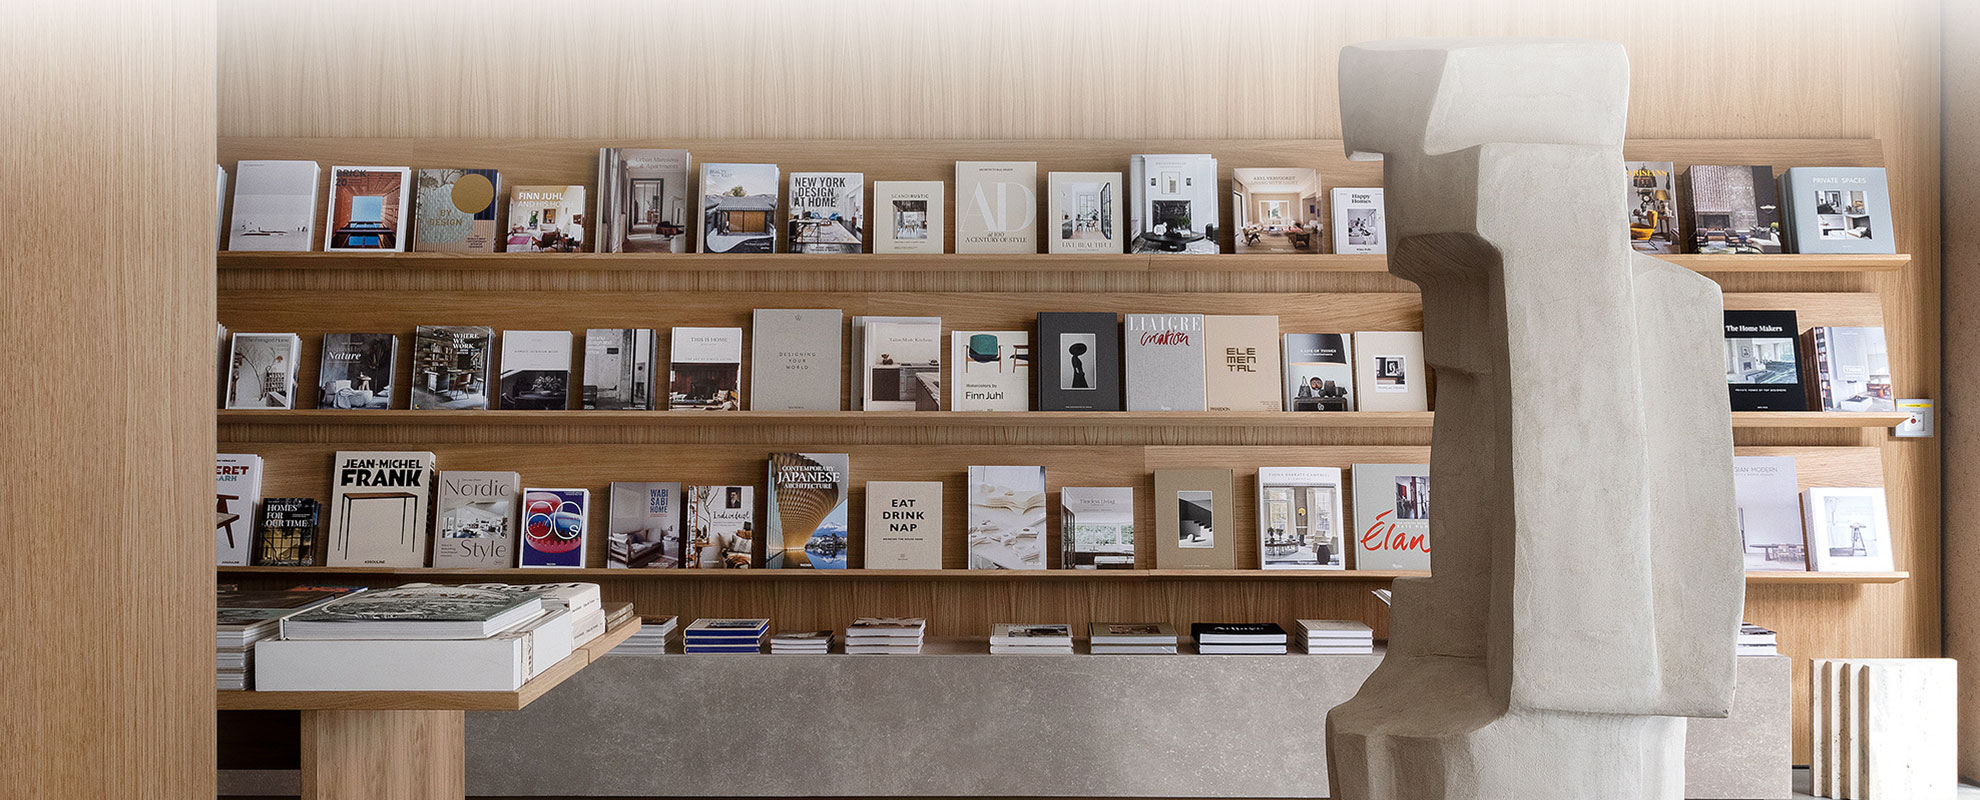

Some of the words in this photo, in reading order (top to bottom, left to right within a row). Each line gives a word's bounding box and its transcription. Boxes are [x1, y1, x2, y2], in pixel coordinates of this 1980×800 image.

[336, 169, 367, 178] BRICK
[335, 178, 348, 187] 20
[794, 177, 816, 188] NEW
[819, 177, 846, 188] YORK
[1812, 176, 1839, 184] PRIVATE
[1841, 176, 1867, 184] SPACES
[518, 192, 540, 200] FINN
[541, 192, 563, 200] JUHL
[797, 187, 834, 197] DESIGN
[793, 197, 805, 208] AT
[808, 197, 836, 208] HOME
[960, 181, 1037, 232] AD
[440, 209, 452, 217] BY
[429, 218, 462, 226] DESIGN
[1129, 316, 1201, 331] LIAIGRE
[1759, 324, 1783, 332] Makers
[329, 351, 362, 360] Nature
[1226, 347, 1256, 355] ELE
[1226, 356, 1256, 364] MEN
[965, 391, 985, 400] Finn
[986, 391, 1004, 400] Juhl
[342, 459, 423, 469] JEAN-MICHEL
[341, 469, 423, 487] FRANK
[777, 471, 841, 485] JAPANESE
[445, 479, 510, 497] Nordic
[650, 488, 669, 497] WABI
[650, 497, 668, 506] SABI
[891, 499, 916, 507] EAT
[267, 504, 298, 512] HOMES
[650, 505, 668, 513] HOME
[266, 511, 284, 519] FOR
[882, 511, 925, 520] DRINK
[265, 519, 284, 527] OUR
[285, 519, 309, 527] TIME
[889, 523, 917, 532] NAP
[1360, 509, 1431, 553] Élan
[460, 540, 507, 563] Style
